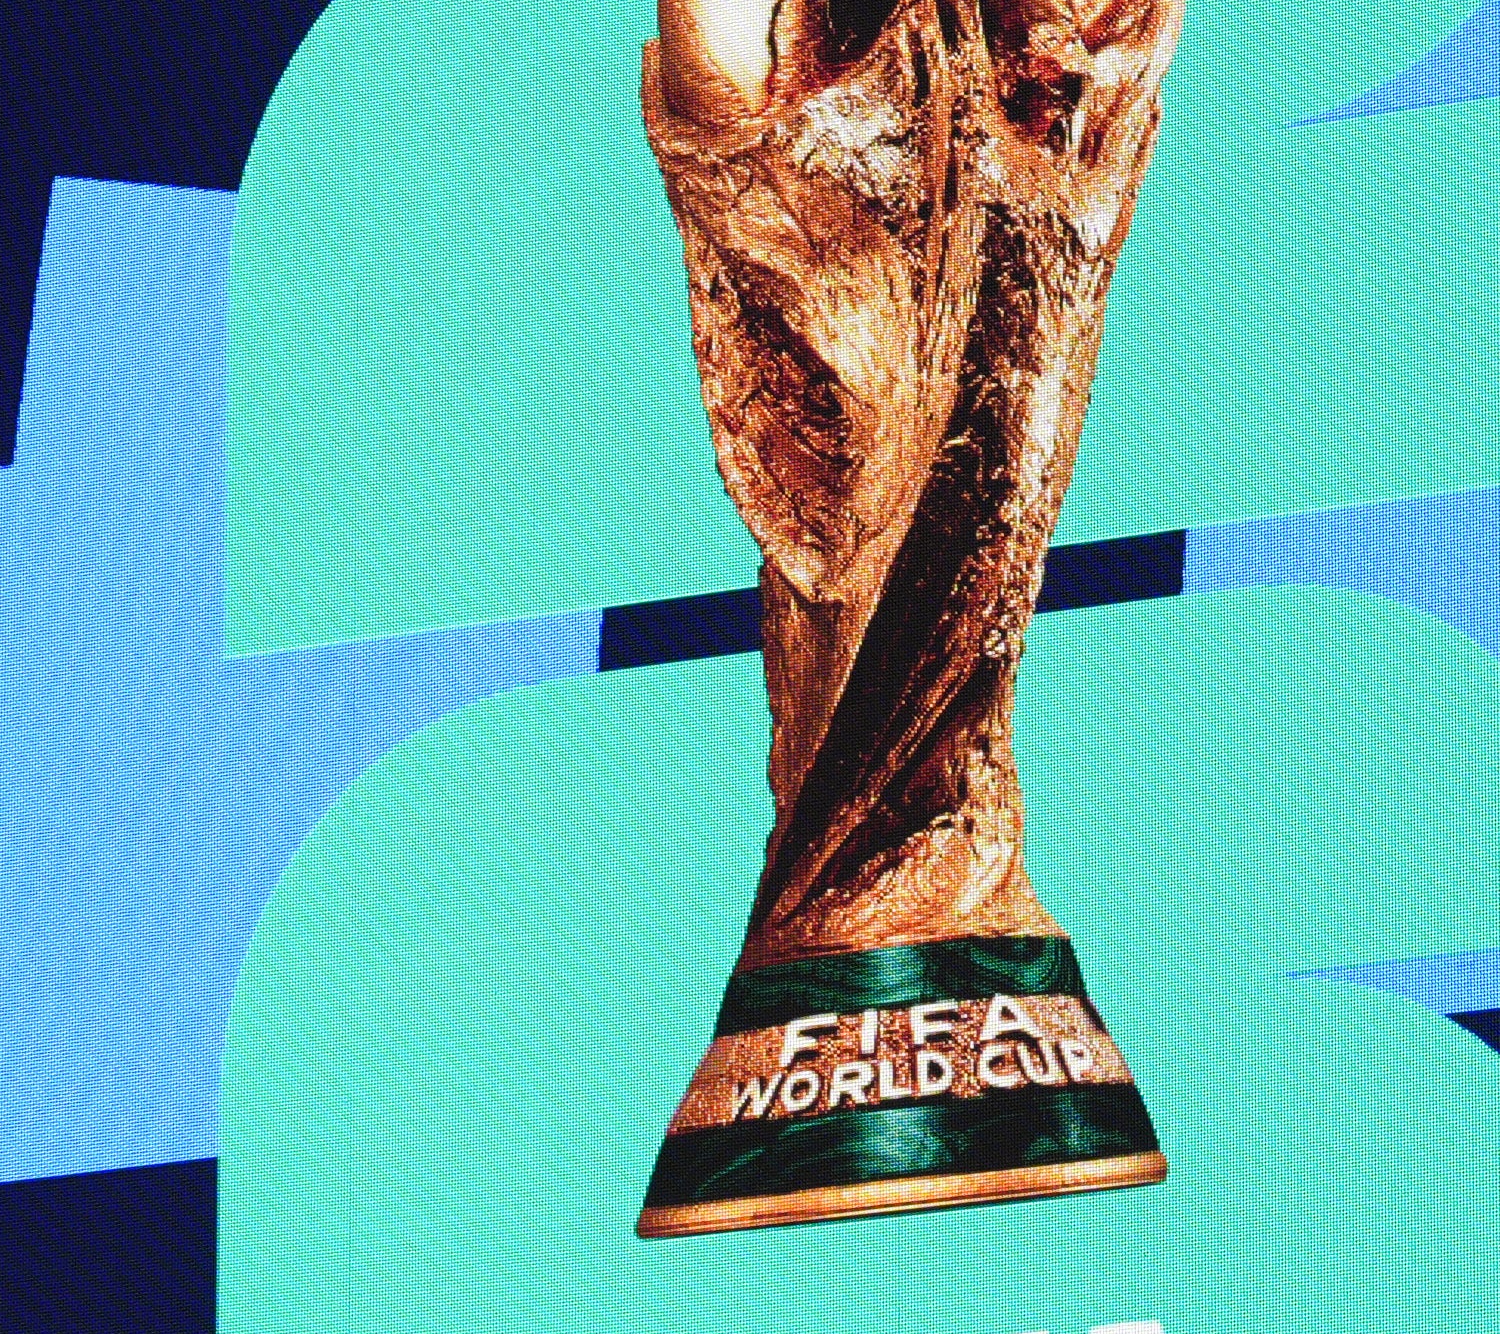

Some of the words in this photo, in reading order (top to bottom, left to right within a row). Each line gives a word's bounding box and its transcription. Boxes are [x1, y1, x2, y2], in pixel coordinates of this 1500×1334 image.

[779, 993, 1051, 1065] FIFA
[732, 1050, 954, 1119] WORLD
[974, 1038, 1095, 1088] CUP
